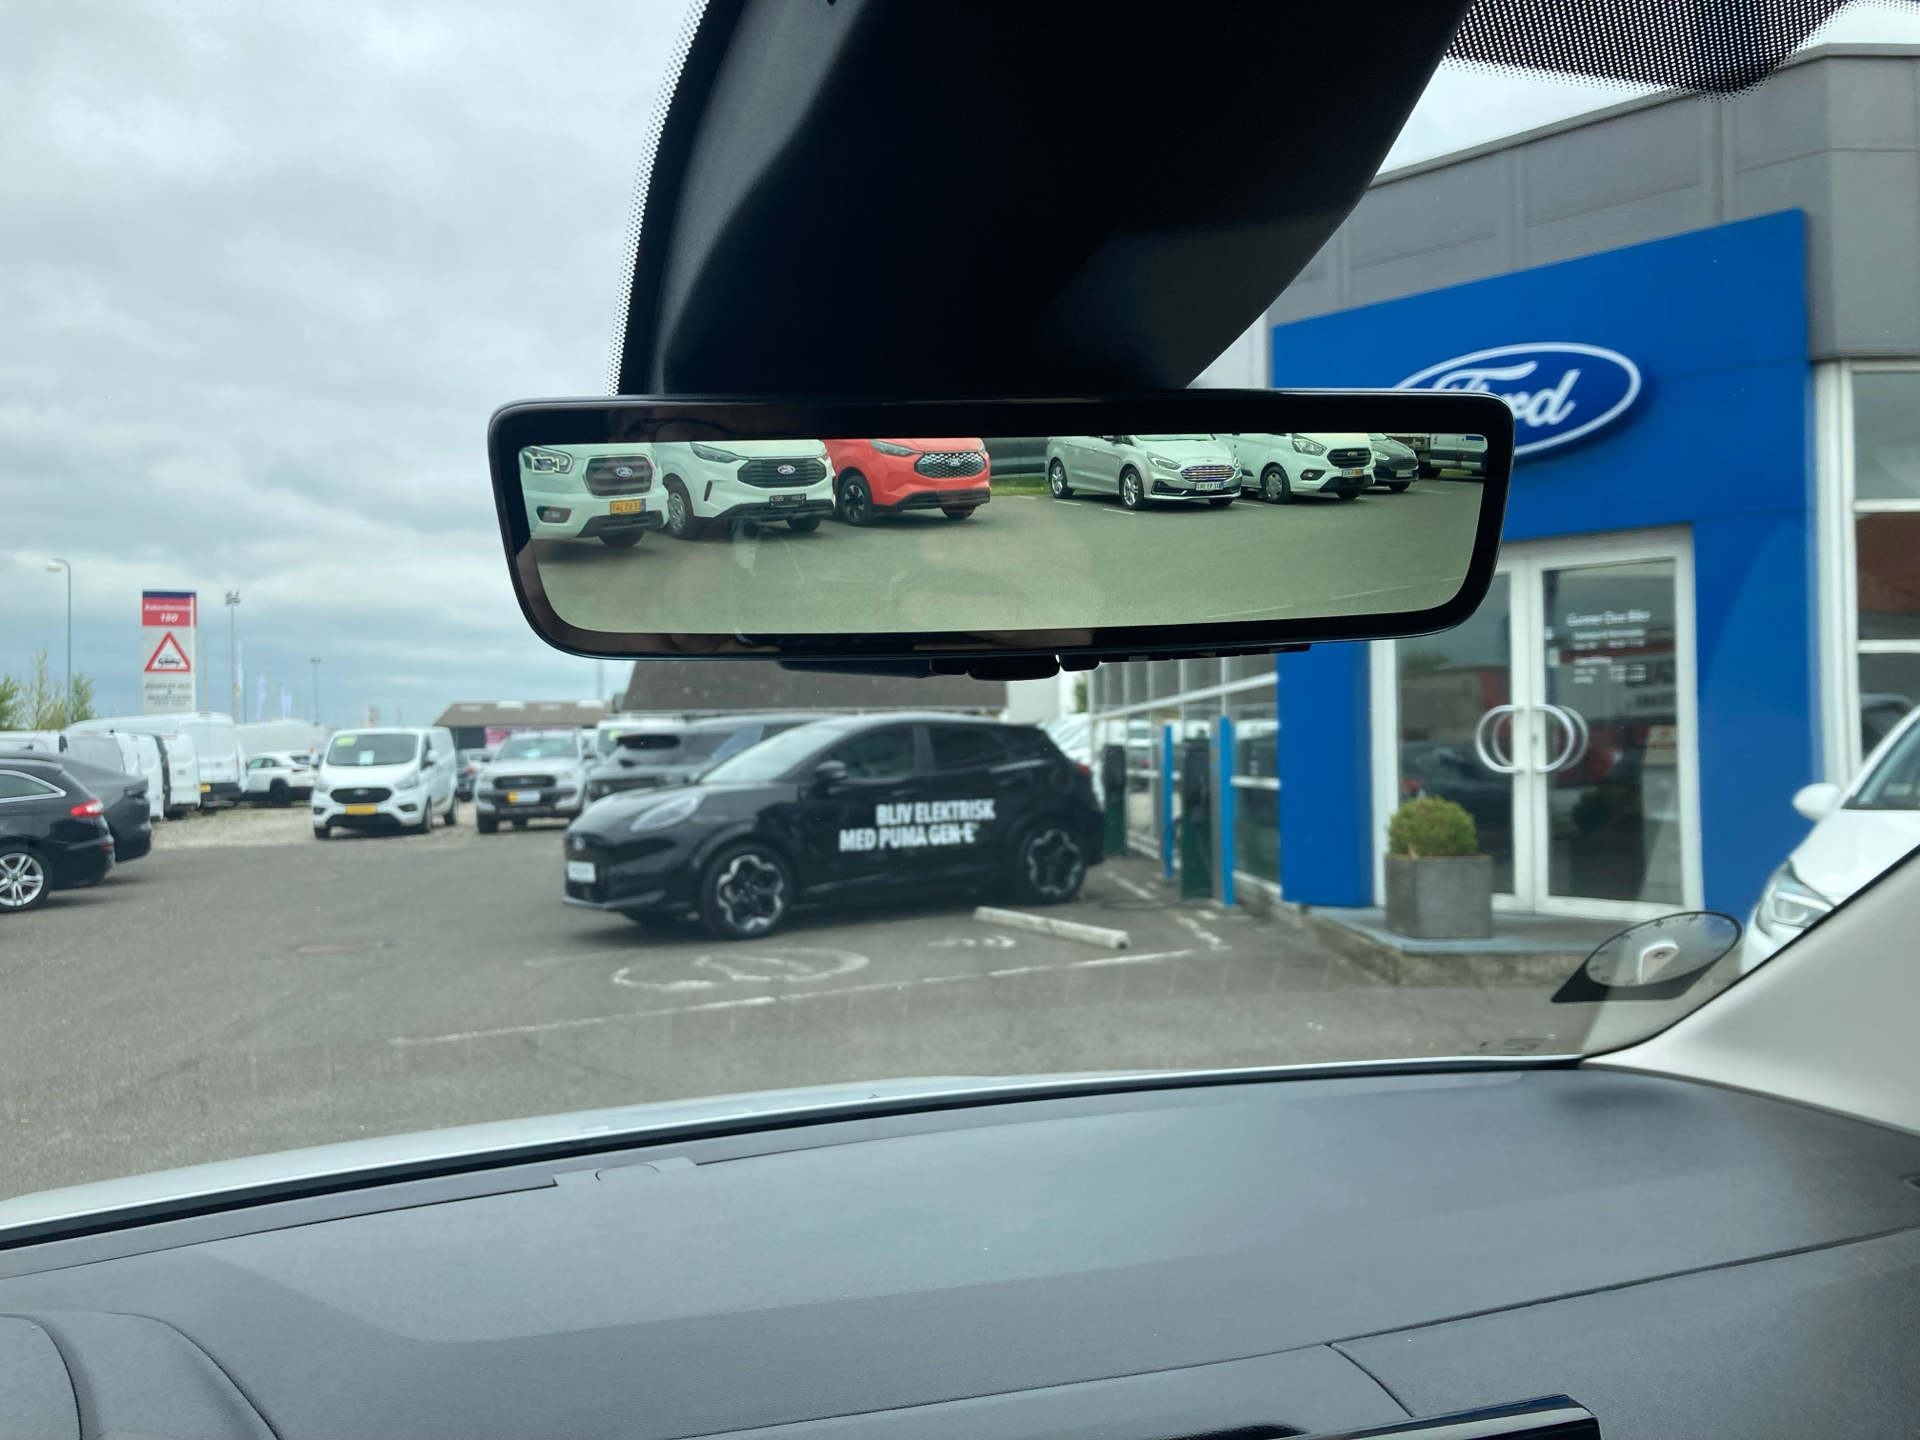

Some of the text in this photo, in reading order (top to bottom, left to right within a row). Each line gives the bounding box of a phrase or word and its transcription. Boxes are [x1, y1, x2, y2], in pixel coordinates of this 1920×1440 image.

[875, 798, 997, 826] BLIV ELEKTRISK
[838, 827, 877, 852] MED
[878, 824, 928, 850] PUMA
